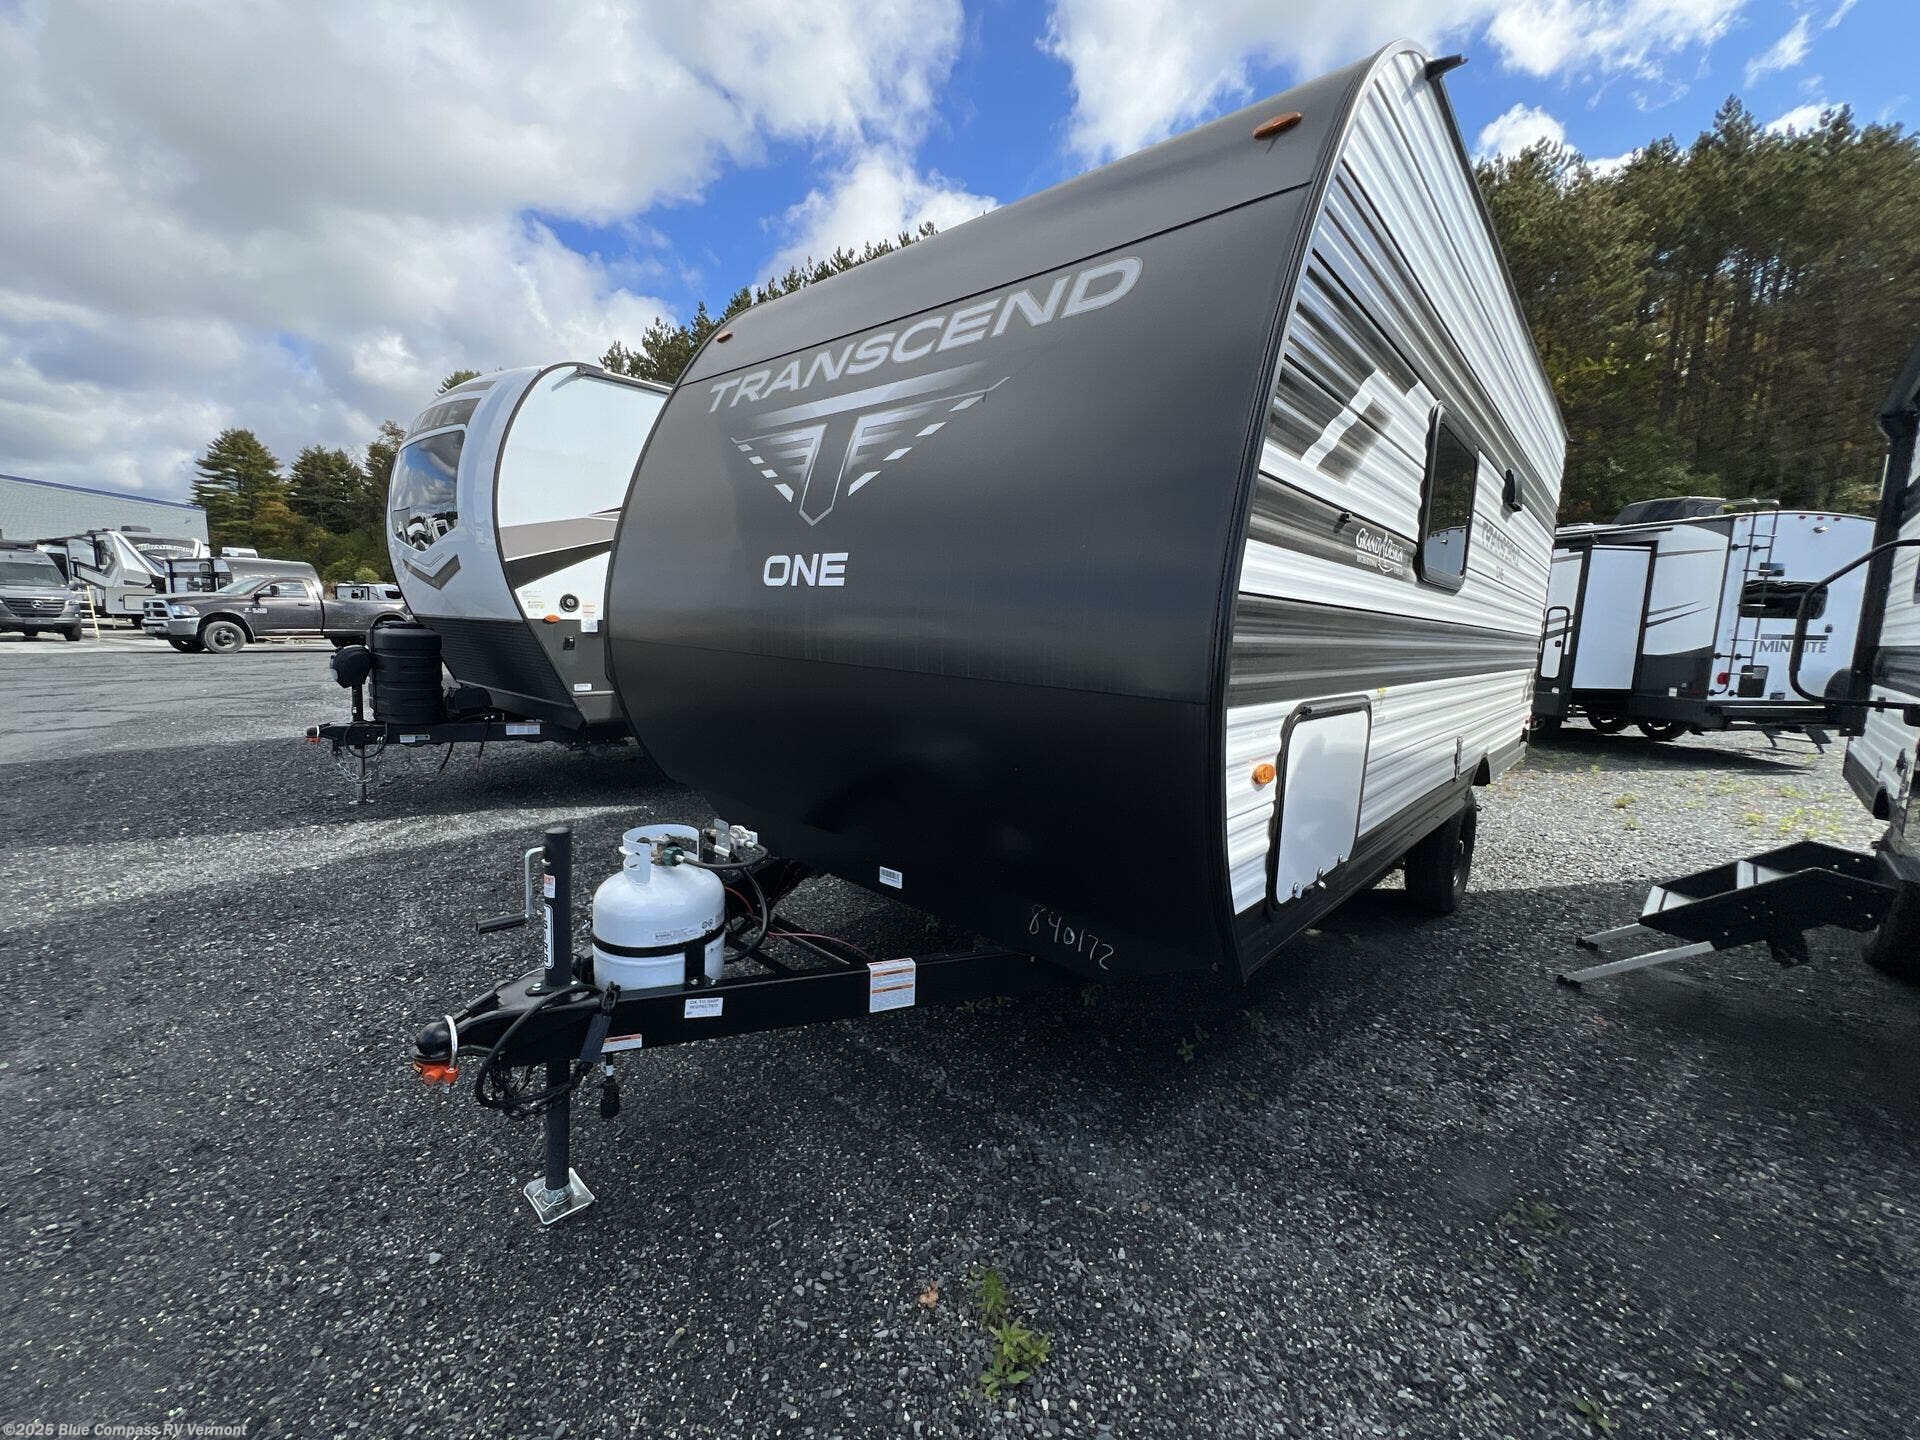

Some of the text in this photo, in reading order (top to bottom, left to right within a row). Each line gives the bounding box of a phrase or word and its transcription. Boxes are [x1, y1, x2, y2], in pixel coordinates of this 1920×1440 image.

[709, 256, 1144, 413] TRANSCEND
[763, 552, 849, 587] ONE
[1029, 904, 1114, 970] 840172
